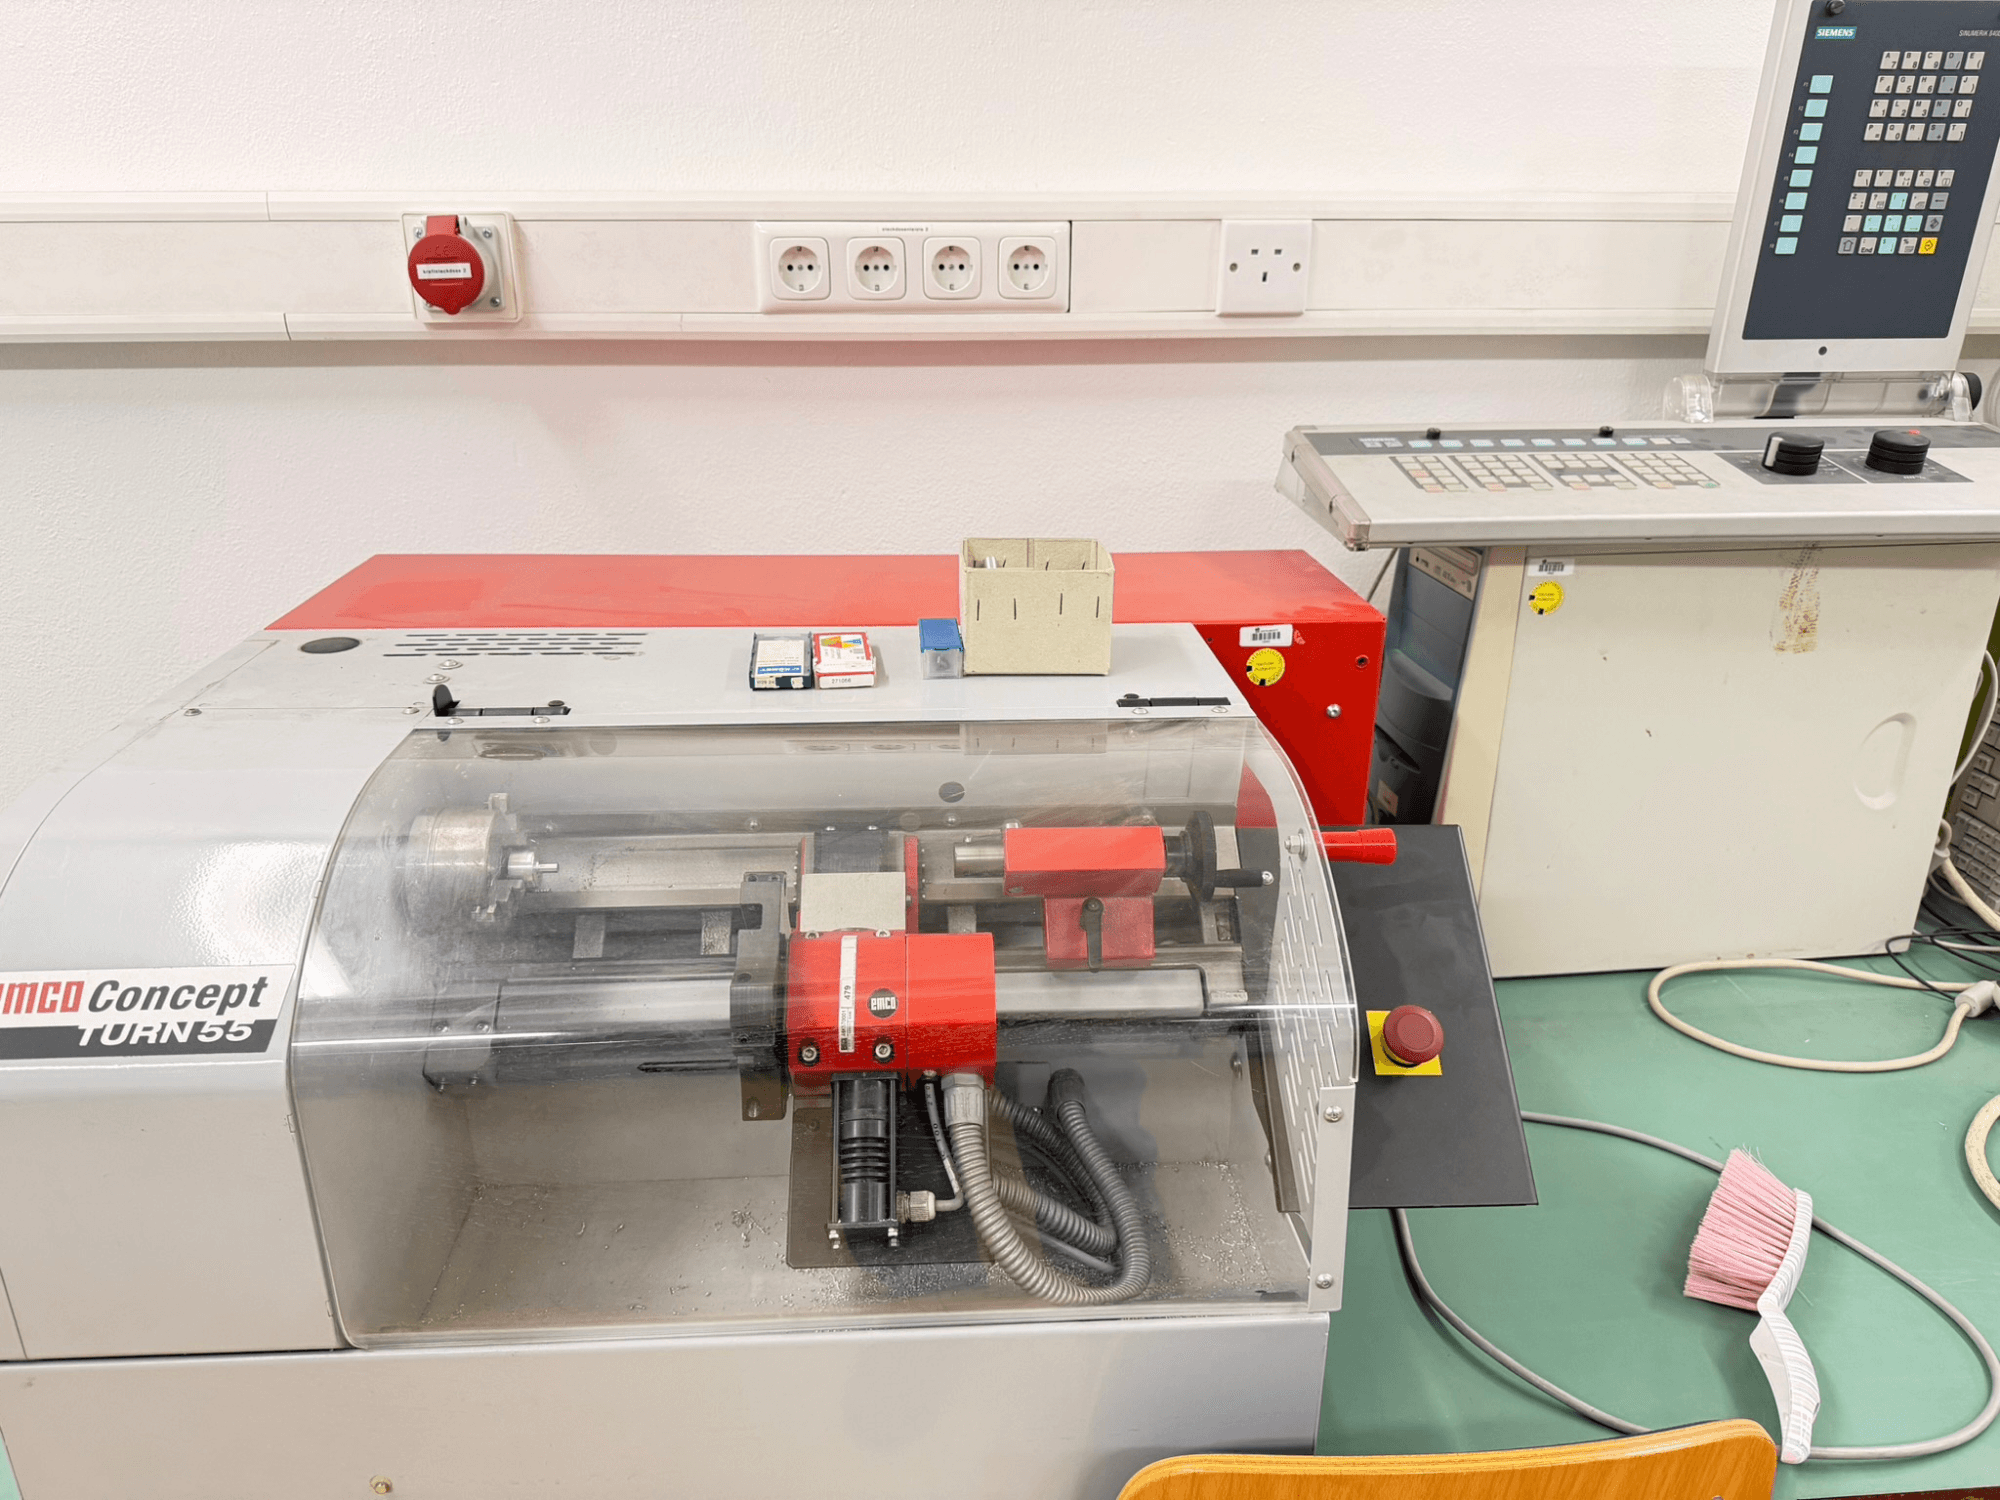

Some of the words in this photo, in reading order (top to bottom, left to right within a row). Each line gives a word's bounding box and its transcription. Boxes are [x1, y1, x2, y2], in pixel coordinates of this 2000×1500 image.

[1816, 28, 1854, 36] SIEMENS
[0, 980, 84, 1014] mco
[88, 976, 268, 1016] Concept
[870, 997, 896, 1010] emco
